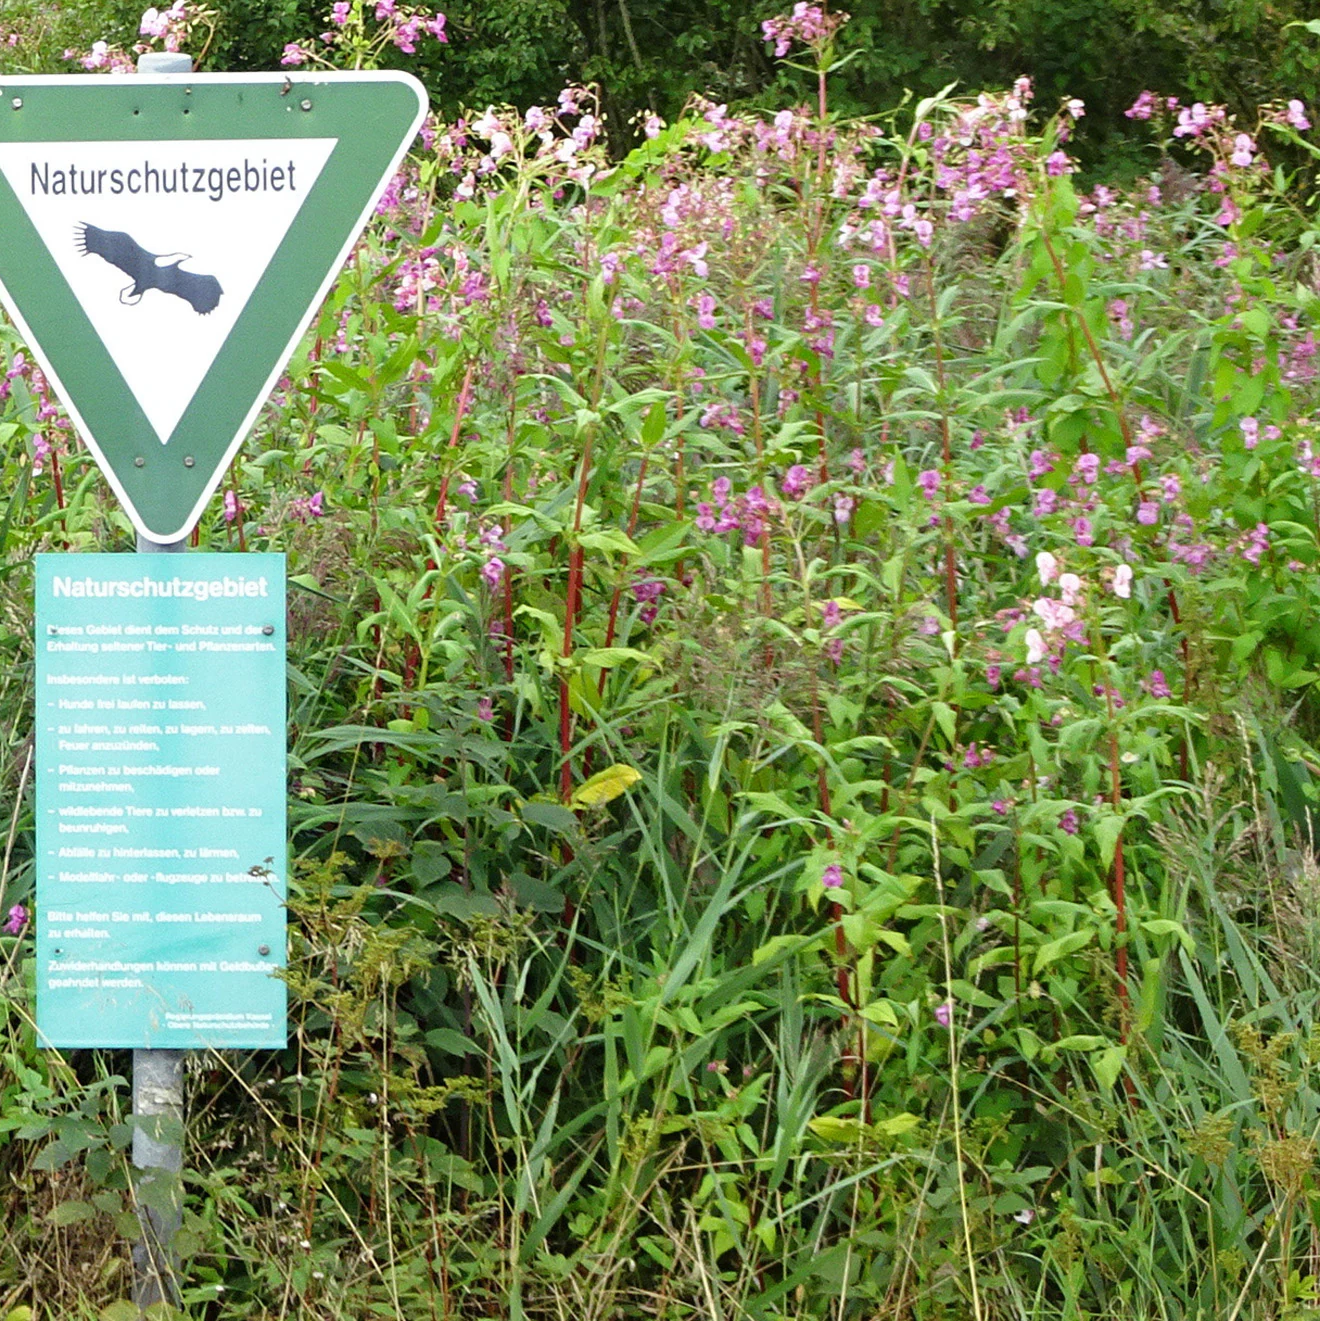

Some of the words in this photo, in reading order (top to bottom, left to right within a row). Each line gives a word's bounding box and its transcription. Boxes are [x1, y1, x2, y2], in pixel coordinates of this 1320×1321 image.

[30, 158, 297, 202] Naturschutzgebiet
[52, 576, 268, 601] Naturschutzgebiet
[86, 624, 122, 636] Gebiet
[125, 624, 151, 635] dient
[155, 625, 178, 636] dem
[182, 624, 219, 635] Schutz
[221, 625, 242, 635] und
[245, 624, 263, 635] der
[47, 640, 98, 654] Erhaltung
[102, 641, 144, 652] seltener
[147, 640, 172, 652] Tier-
[176, 641, 196, 652] und
[199, 640, 276, 652] Pflanzenarten.
[47, 674, 119, 685] Insbesondere
[123, 674, 136, 685] ist
[138, 674, 189, 685] verboten:
[59, 698, 94, 710] Hunde
[97, 698, 115, 710] frei
[117, 699, 149, 710] laufen
[152, 700, 165, 710] zu
[168, 699, 206, 710] lassen,
[58, 725, 71, 735] zu
[74, 723, 111, 735] fahren,
[114, 725, 126, 735] zu
[129, 723, 162, 735] reiten,
[165, 725, 178, 735] zu
[181, 724, 217, 736] lagern,
[220, 725, 233, 735] zu
[236, 723, 271, 735] zelten,
[59, 739, 89, 751] Feuer
[92, 740, 160, 751] anzuzünden,
[59, 764, 105, 776] Pflanzen
[108, 766, 120, 776] zu
[123, 764, 192, 778] beschädigen
[195, 765, 220, 776] oder
[59, 781, 135, 793] mitzunehmen,
[59, 805, 123, 817] wildlebende
[126, 805, 153, 817] Tiere
[155, 807, 168, 817] zu
[171, 806, 219, 817] verletzen
[222, 806, 245, 817] bzw.
[248, 807, 262, 817] zu
[59, 847, 94, 858] Abfälle
[98, 848, 111, 858] zu
[113, 846, 181, 858] hinterlassen,
[184, 849, 197, 858] zu
[123, 872, 147, 883] oder
[210, 873, 223, 883] zu
[47, 910, 72, 922] Bitte
[76, 911, 109, 923] helfen
[112, 911, 129, 923] Sie
[132, 911, 153, 923] mit,
[156, 911, 192, 923] diesen
[194, 911, 262, 923] Lebensraum
[48, 929, 61, 939] zu
[64, 927, 110, 939] erhalten.
[48, 959, 154, 974] Zuwiderhandlungen
[156, 961, 197, 972] können
[200, 961, 217, 972] mit
[48, 977, 99, 990] geahndet
[102, 977, 144, 988] werden.
